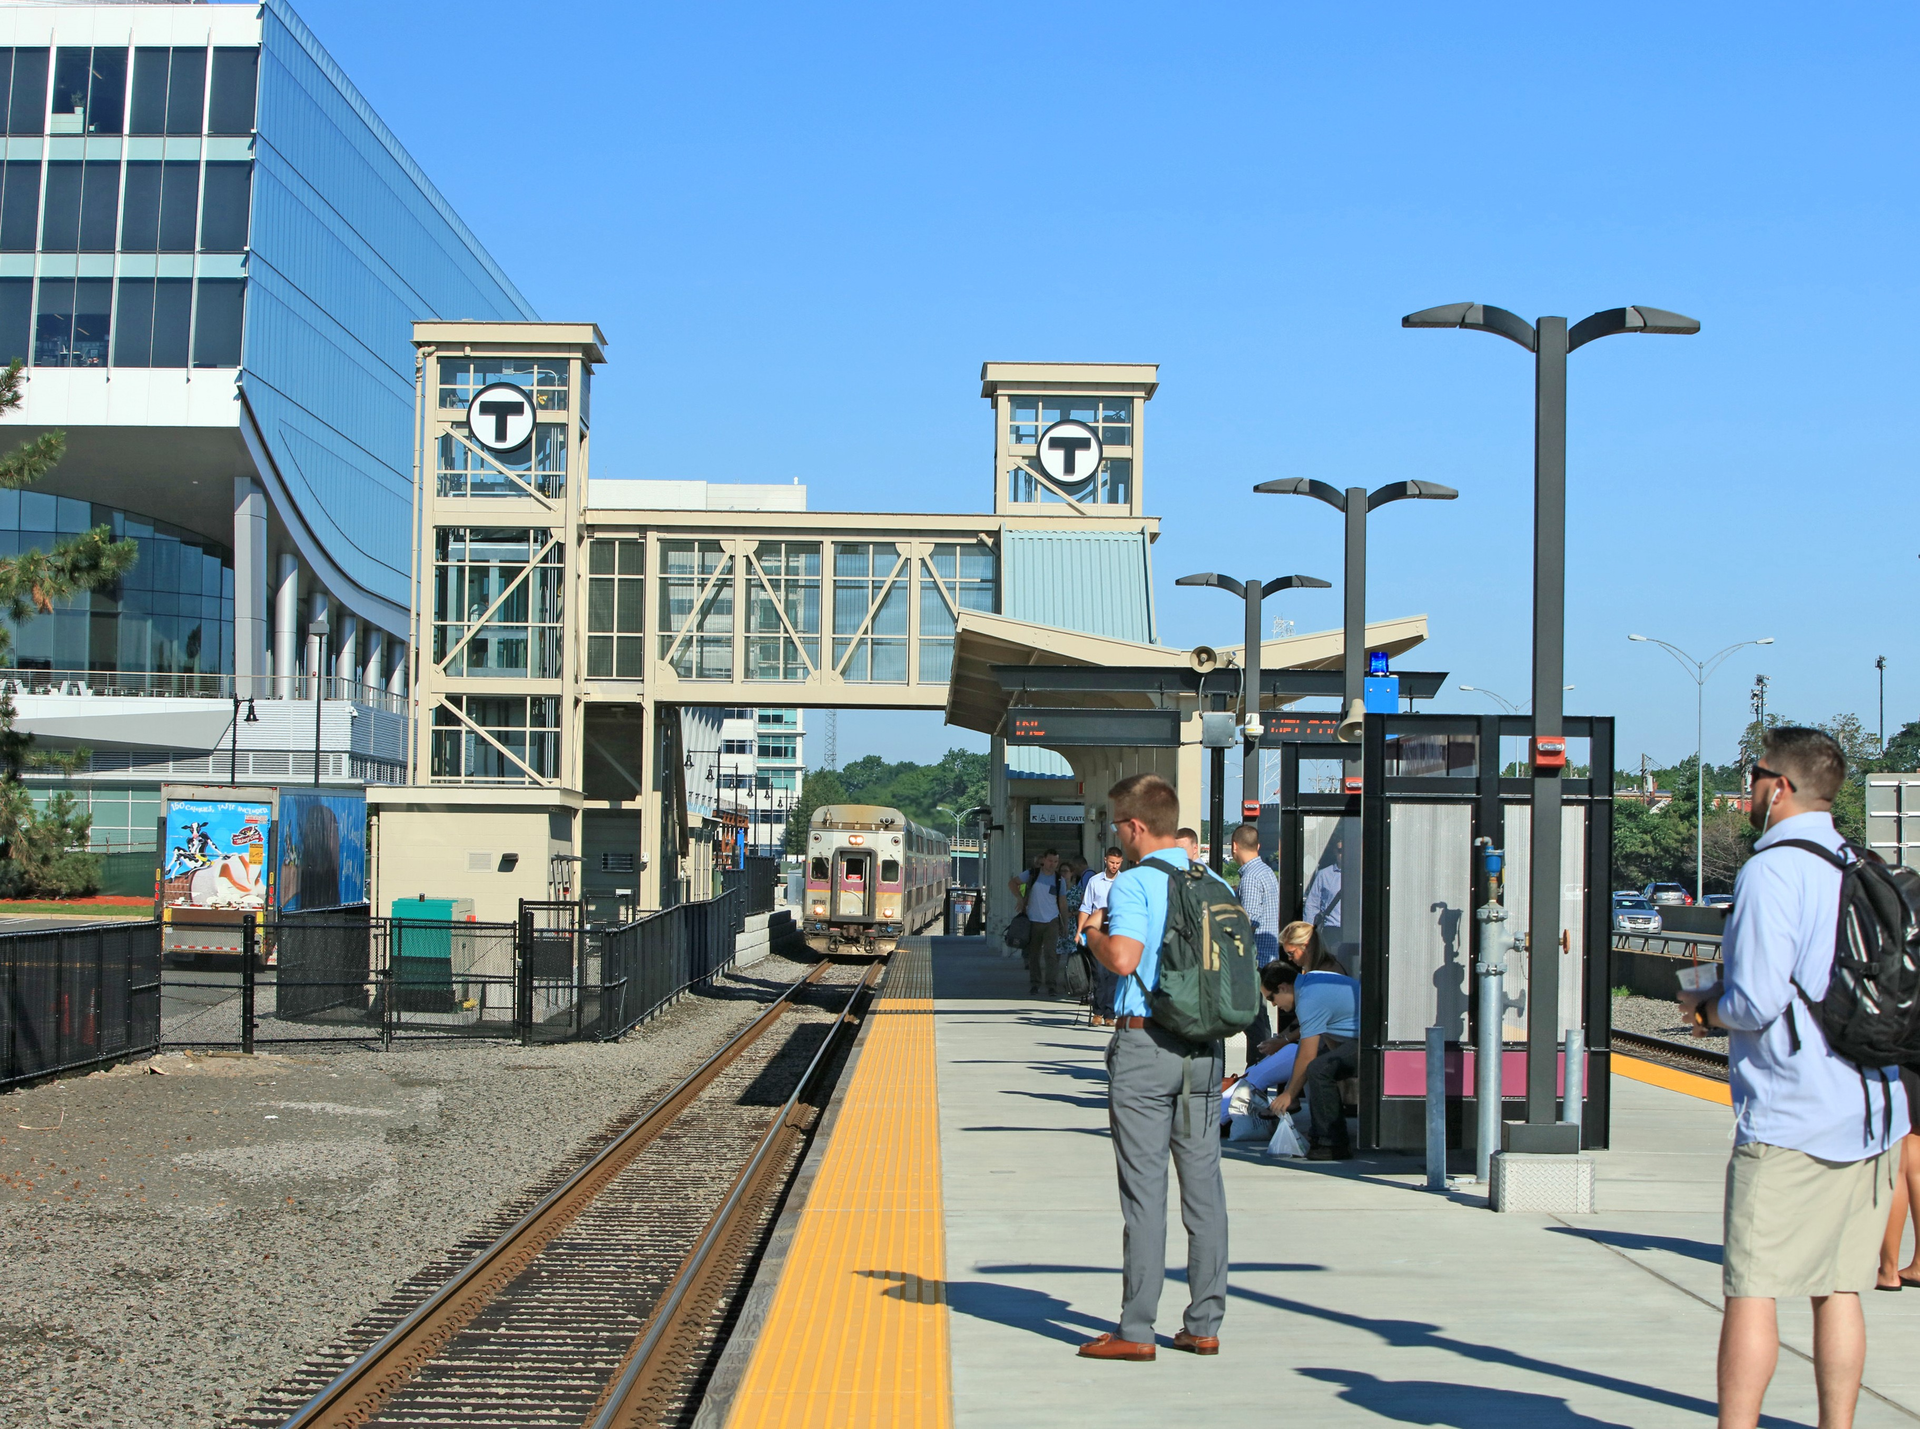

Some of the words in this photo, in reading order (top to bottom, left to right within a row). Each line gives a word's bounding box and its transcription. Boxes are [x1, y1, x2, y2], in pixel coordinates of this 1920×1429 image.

[479, 401, 524, 443] T
[1048, 437, 1091, 476] T
[171, 802, 185, 811] 150
[217, 803, 236, 811] TASTE
